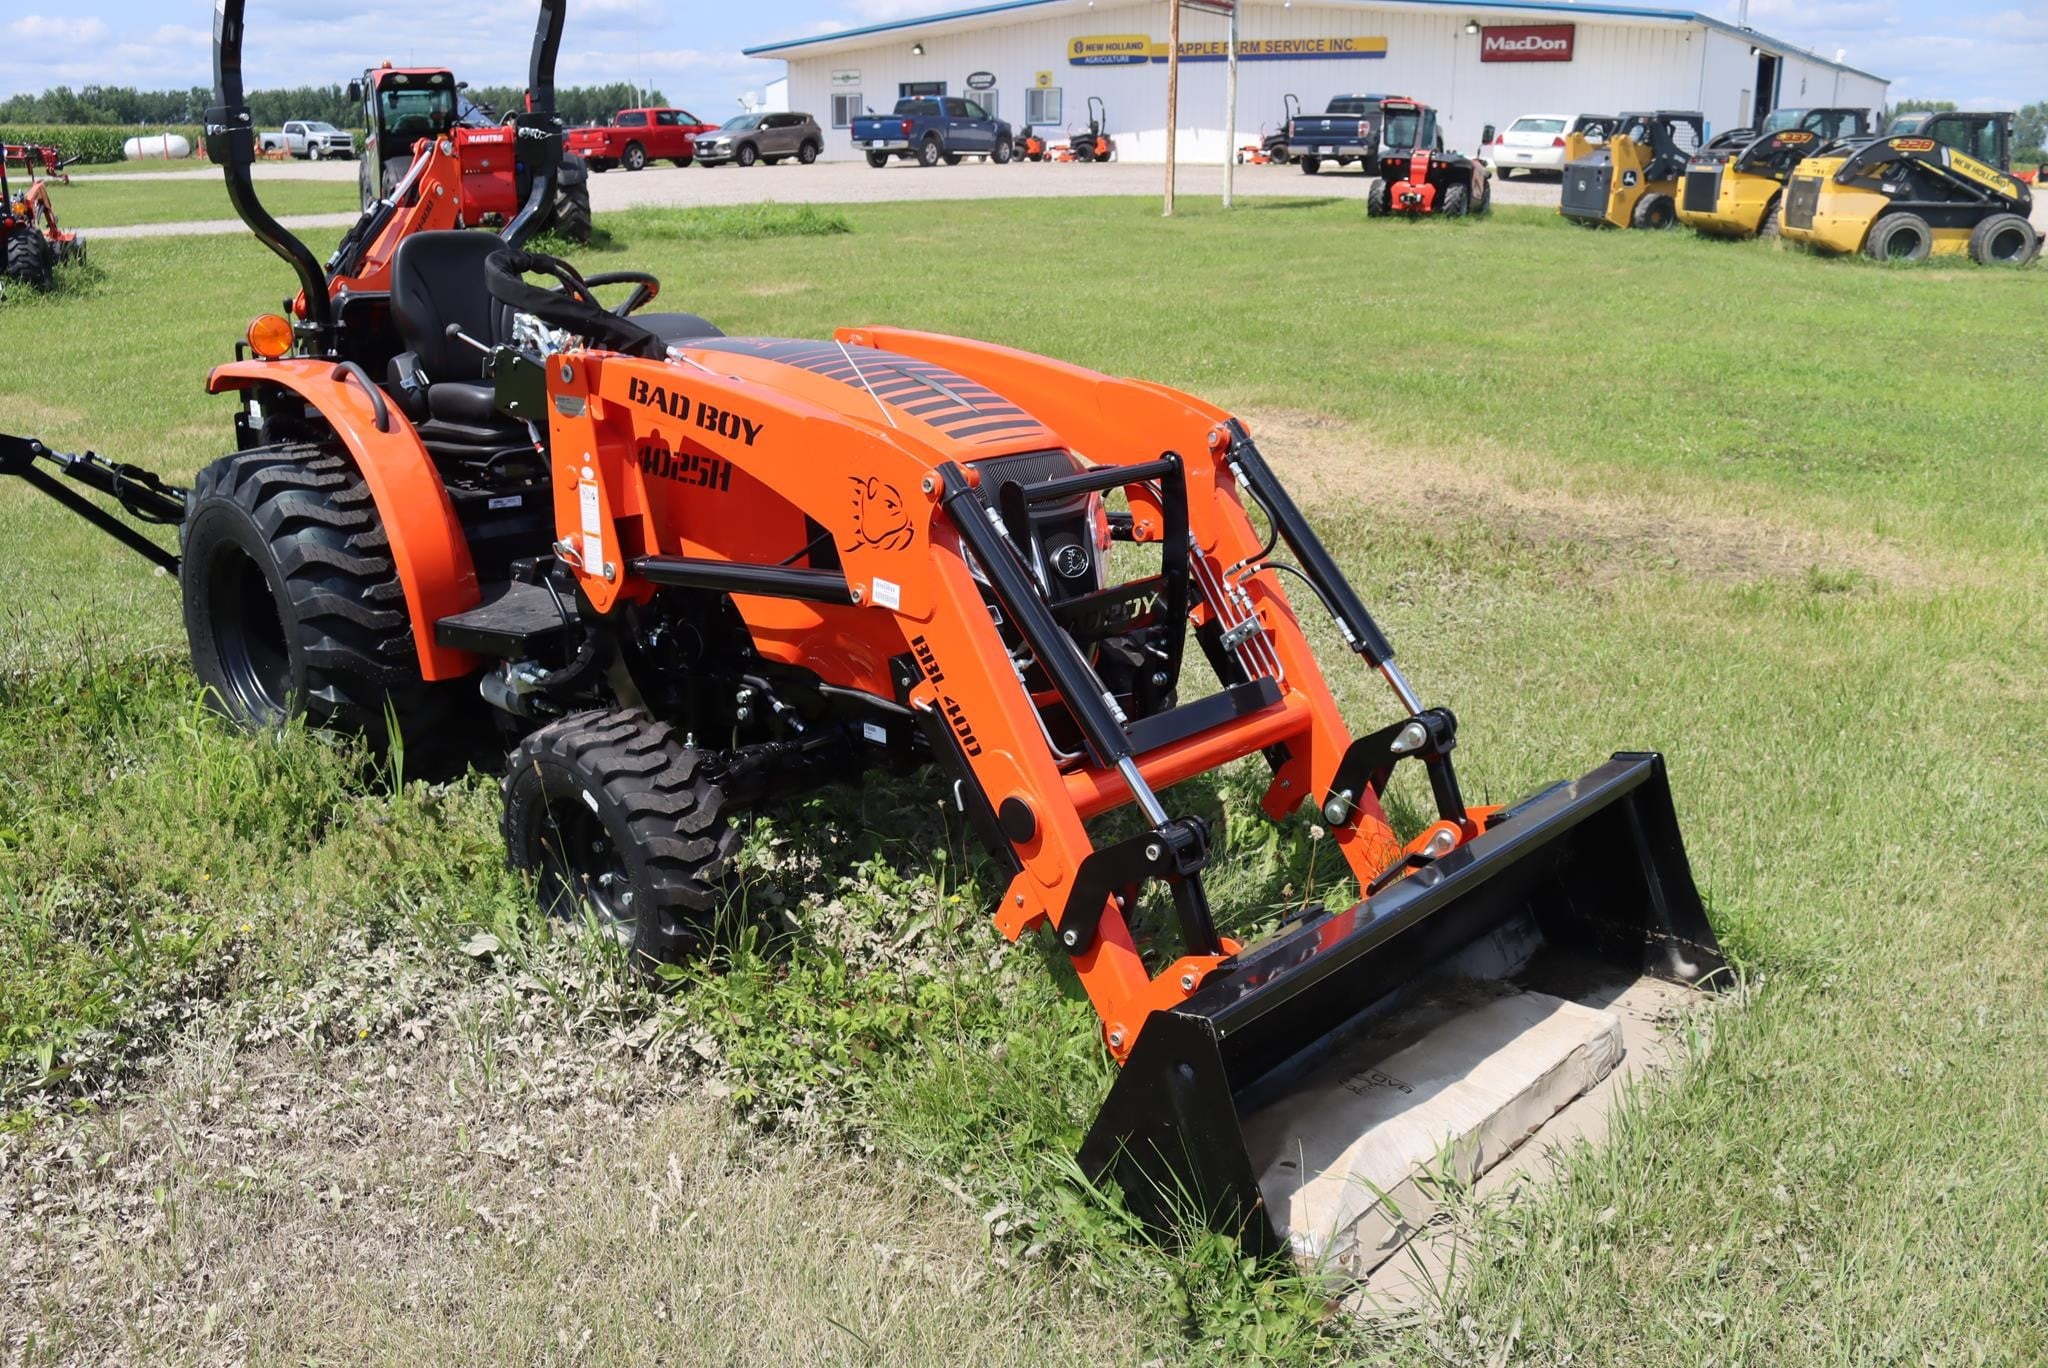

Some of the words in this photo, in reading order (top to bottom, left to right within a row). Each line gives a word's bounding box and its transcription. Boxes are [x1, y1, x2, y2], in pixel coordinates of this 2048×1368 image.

[1086, 43, 1104, 52] NEW
[1106, 41, 1144, 51] HOLLAND
[1177, 42, 1219, 55] APPLE
[1223, 41, 1260, 54] FRM
[1264, 39, 1325, 54] SERVICE
[1329, 38, 1357, 51] INC.
[1485, 36, 1567, 50] MacDon
[1085, 55, 1130, 63] AGRICULTURE
[1953, 157, 1972, 170] NEW
[1972, 166, 2007, 188] HOLLAND
[629, 376, 690, 421] BAD
[696, 402, 764, 446] BOY
[638, 445, 732, 492] 4025H
[943, 696, 982, 757] 400
